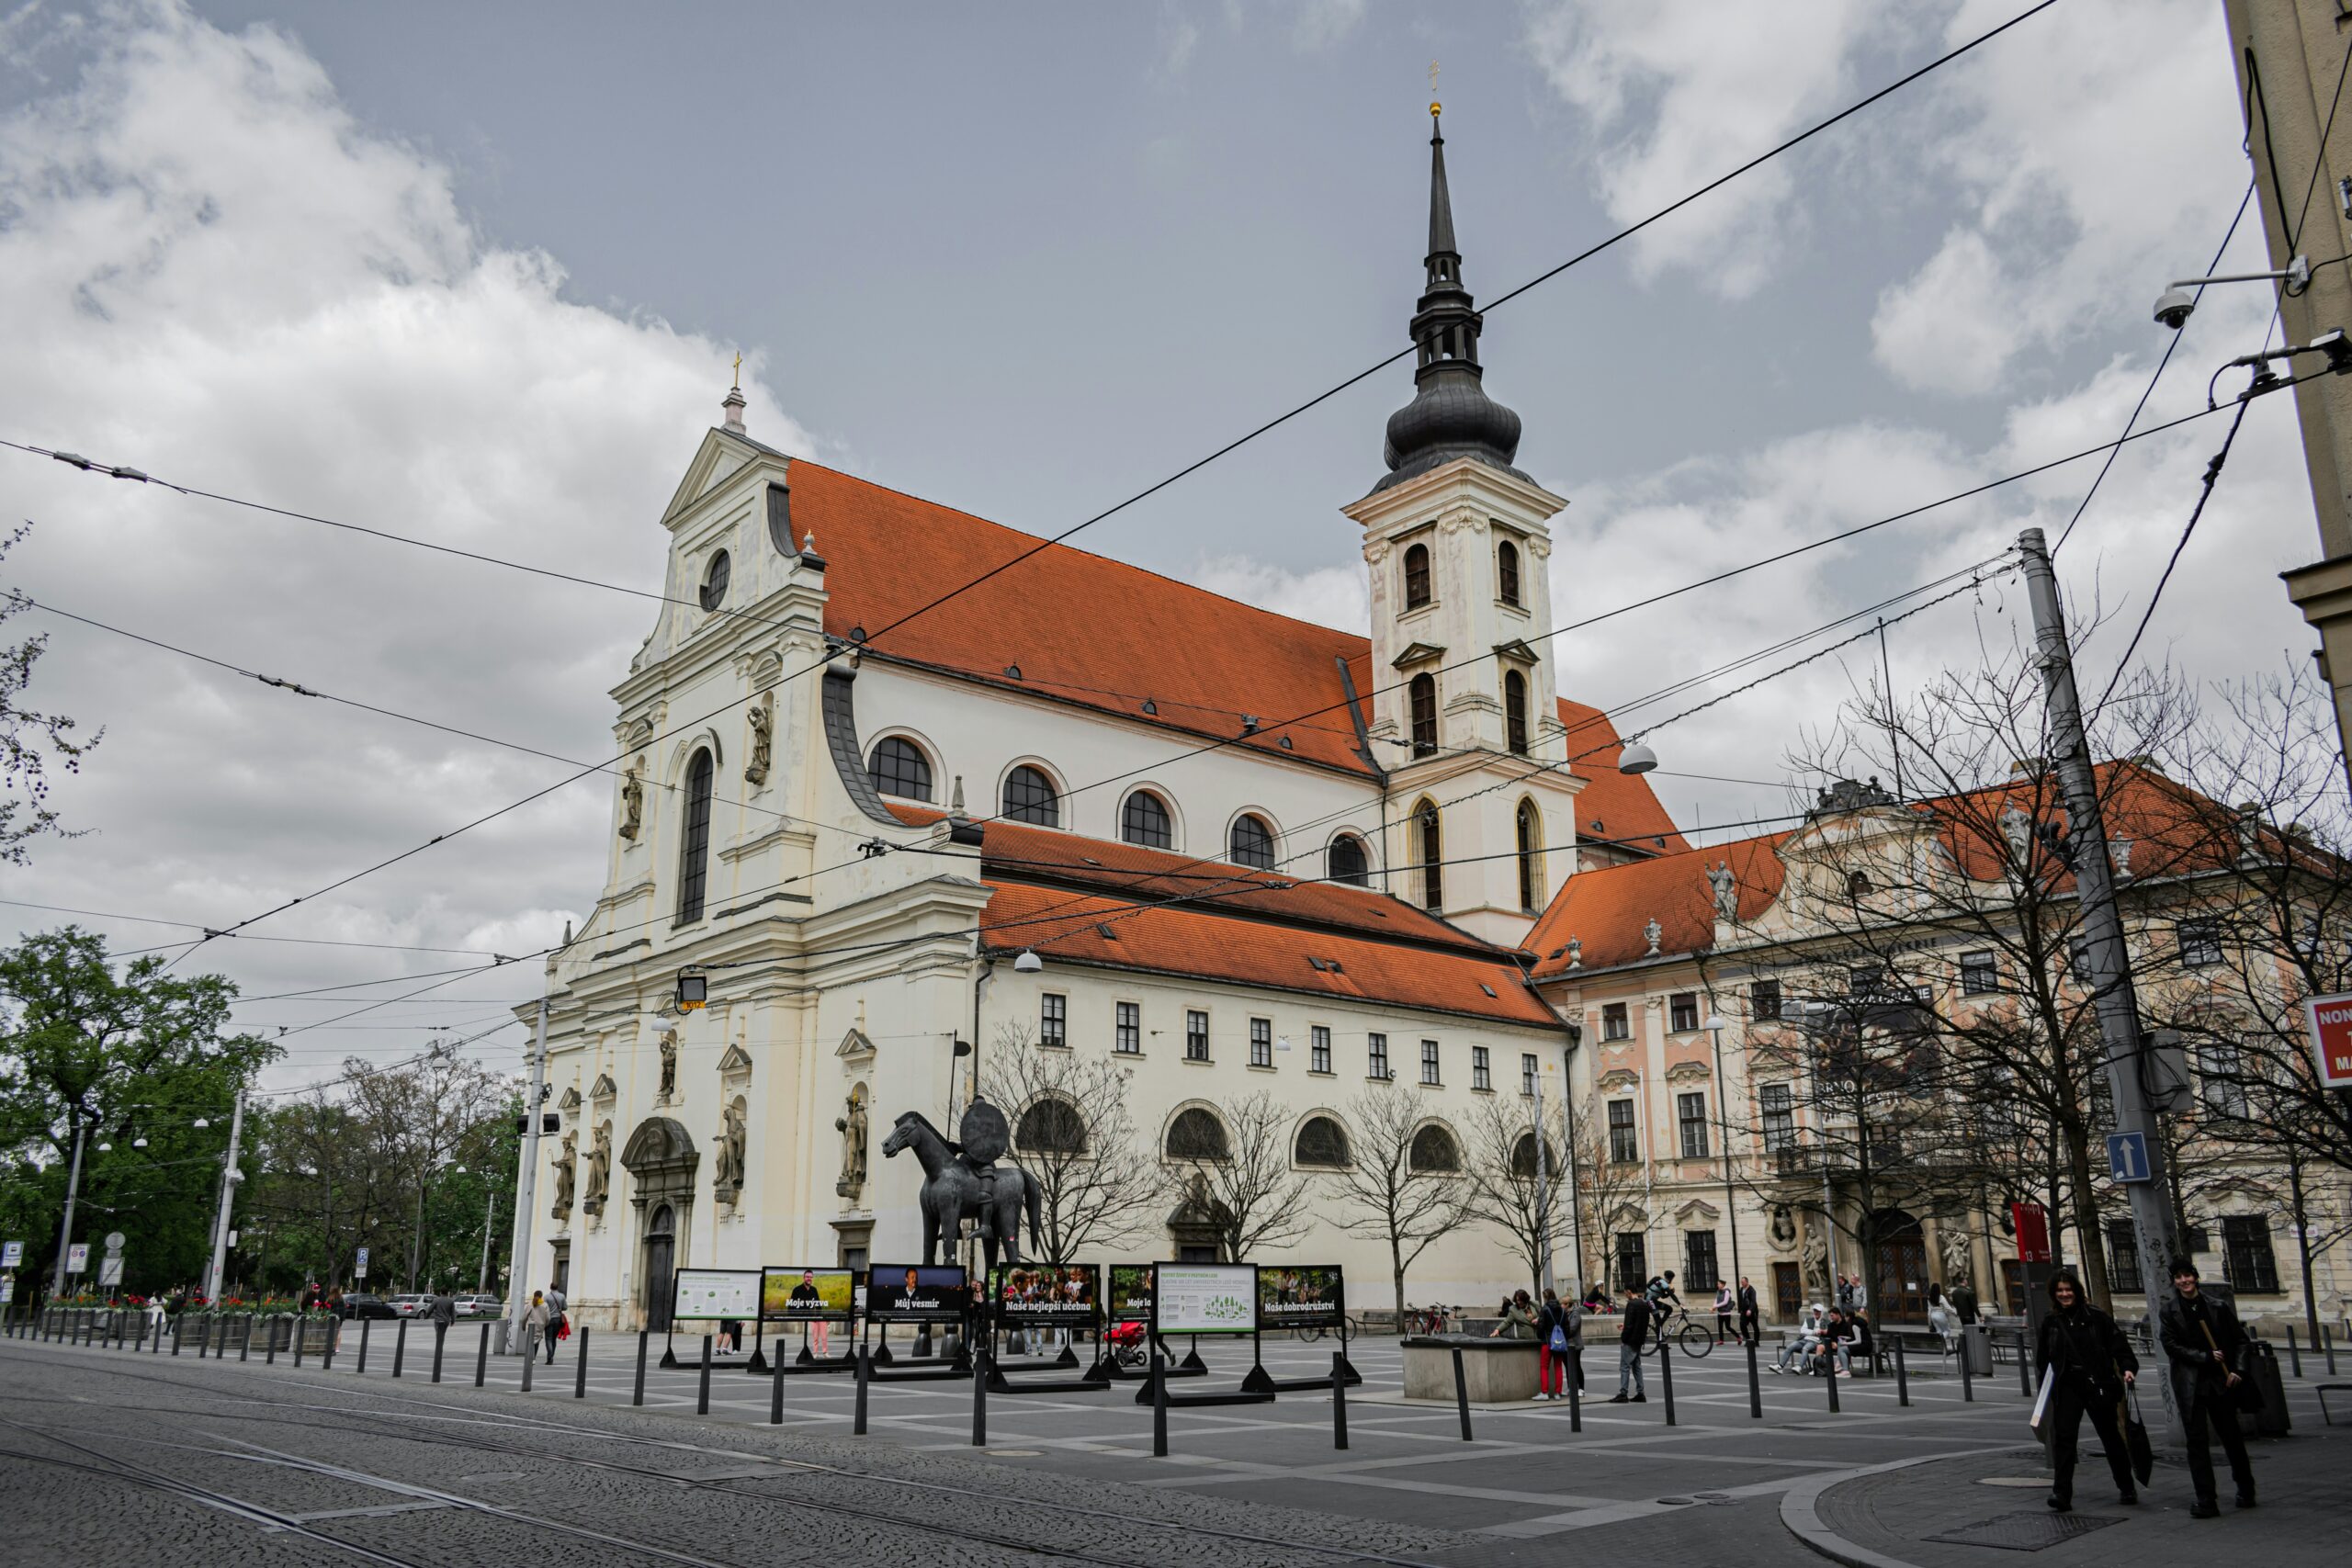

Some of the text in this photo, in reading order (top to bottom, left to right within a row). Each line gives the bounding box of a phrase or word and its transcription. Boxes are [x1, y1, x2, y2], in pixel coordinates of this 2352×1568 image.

[2025, 1250, 2033, 1262] 13
[786, 1297, 829, 1309] Moje výzva
[894, 1297, 940, 1310] Můj vesmír
[1005, 1300, 1091, 1314] Naše nejlepší učebna
[1126, 1297, 1144, 1309] Moje
[1264, 1300, 1336, 1313] Naše dobrodružství
